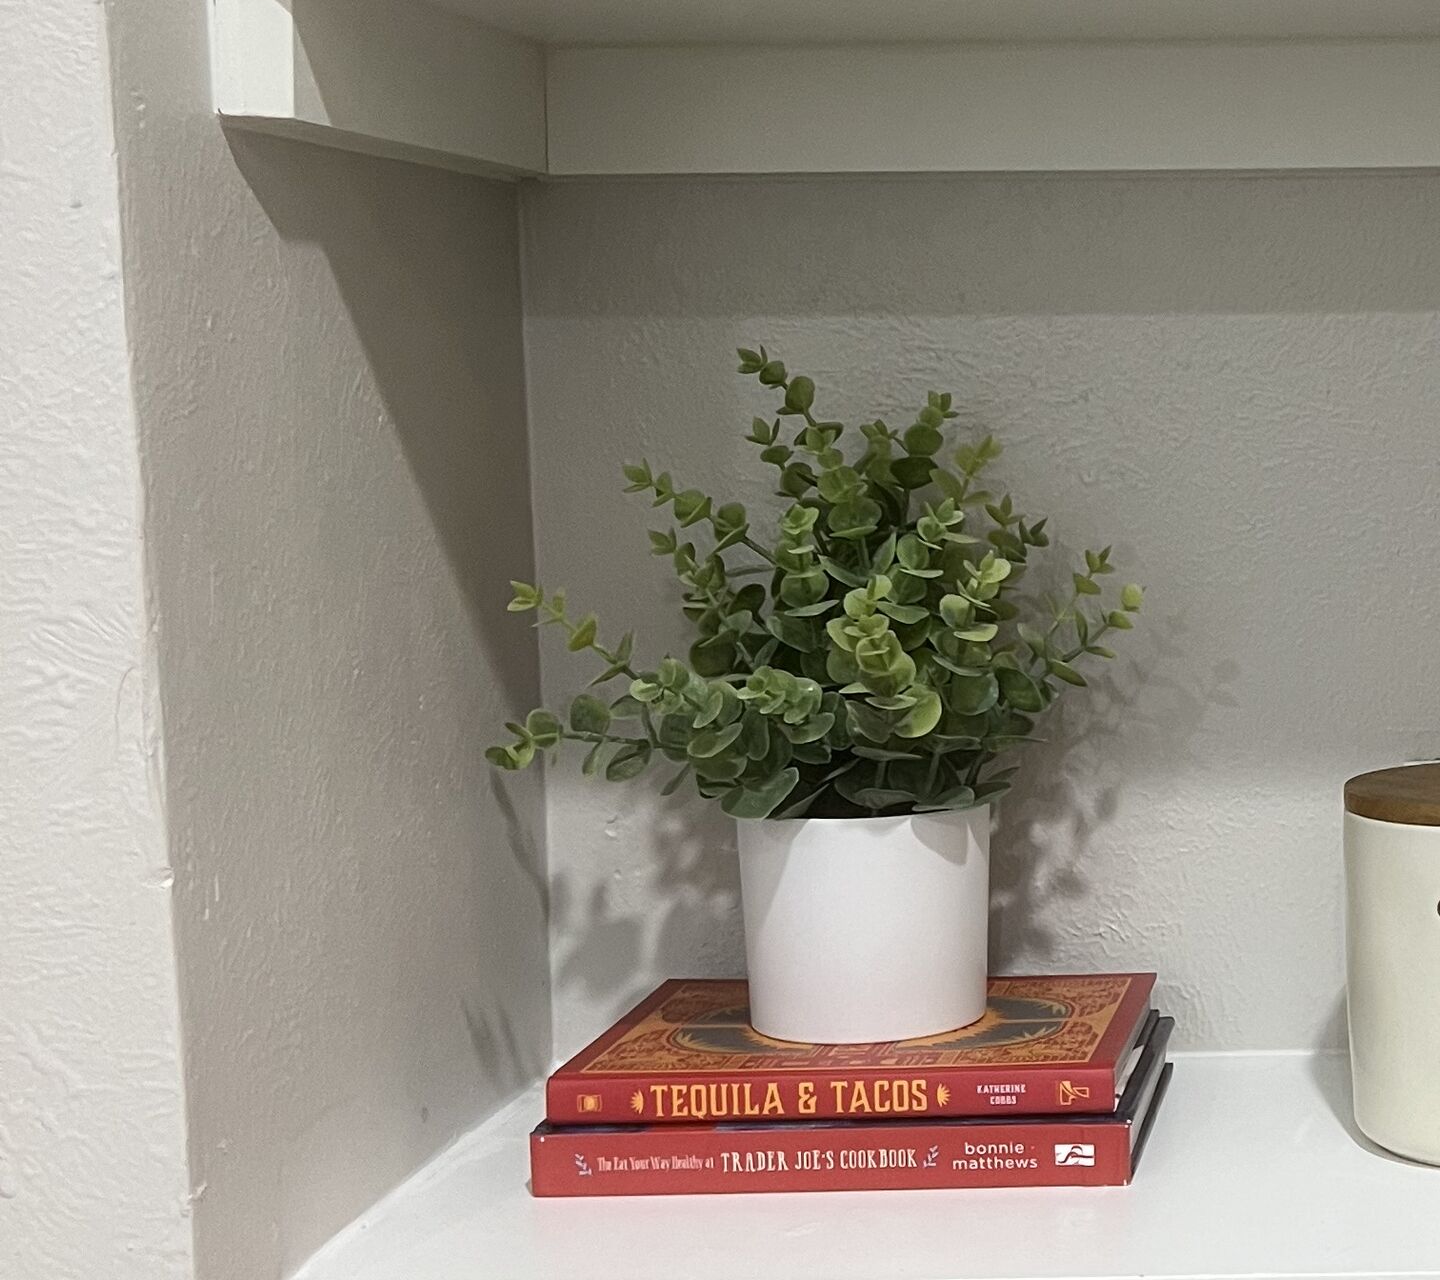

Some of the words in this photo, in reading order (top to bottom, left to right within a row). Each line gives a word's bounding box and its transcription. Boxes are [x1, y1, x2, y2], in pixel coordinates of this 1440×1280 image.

[976, 1084, 1027, 1094] KATHERINE
[650, 1082, 785, 1119] TEQUILA
[798, 1081, 817, 1114] &
[830, 1079, 928, 1113] TACOS
[964, 1142, 1025, 1155] bonnie
[597, 1157, 612, 1172] The
[629, 1156, 649, 1171] Your
[650, 1155, 670, 1172] Way
[721, 1151, 789, 1173] TRADER
[794, 1149, 834, 1171] JOE'S
[840, 1148, 918, 1169] COOKBOOK
[952, 1157, 1038, 1170] matthews
